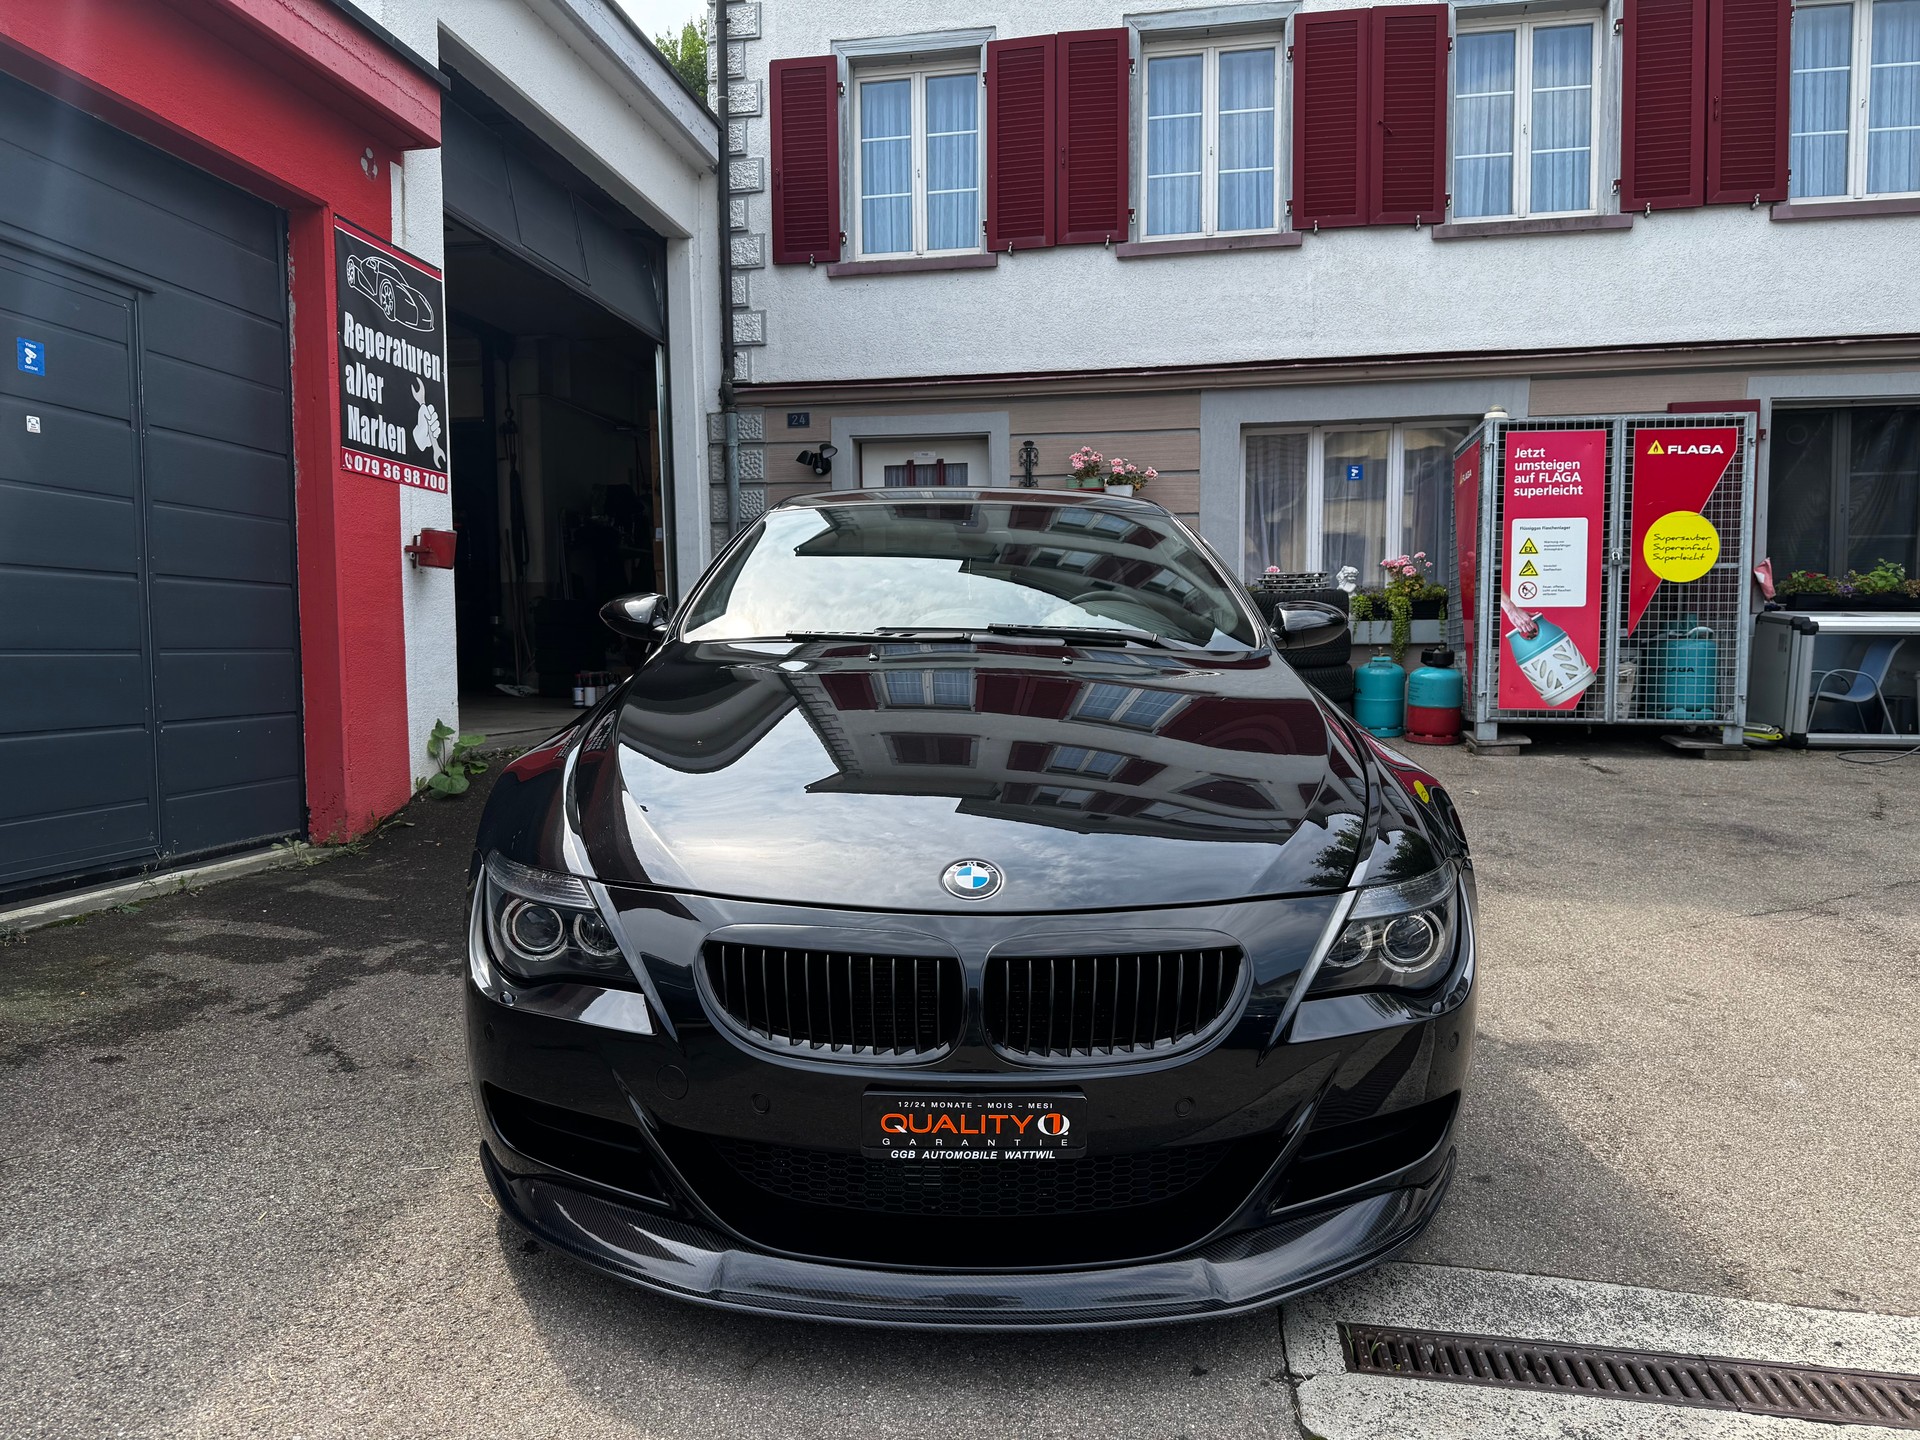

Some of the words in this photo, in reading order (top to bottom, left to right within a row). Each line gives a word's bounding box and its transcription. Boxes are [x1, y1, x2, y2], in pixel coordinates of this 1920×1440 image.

[344, 311, 441, 383] Reperaturen
[345, 361, 384, 405] aller
[791, 414, 806, 425] 24
[347, 404, 407, 455] Marken
[1514, 447, 1546, 459] Jetzt
[1667, 444, 1724, 455] FLAGA
[1514, 459, 1581, 473] umsteigen
[354, 455, 380, 476] 079
[383, 462, 401, 480] 36
[403, 468, 421, 485] 98
[423, 472, 446, 491] 700
[1514, 472, 1536, 484] auf
[1539, 471, 1582, 483] FLAGA
[1513, 484, 1584, 499] superleicht
[1653, 533, 1712, 544] Supersauber
[1653, 542, 1713, 554] Supereinfach
[1652, 552, 1706, 564] Superleicht
[931, 1101, 973, 1109] MONATE
[880, 1113, 1034, 1135] QUALITY
[882, 1138, 1069, 1147] GARANTIE
[890, 1150, 916, 1160] GGB
[921, 1150, 998, 1160] AUTOMOBILE
[1004, 1150, 1056, 1160] WATTWIL
